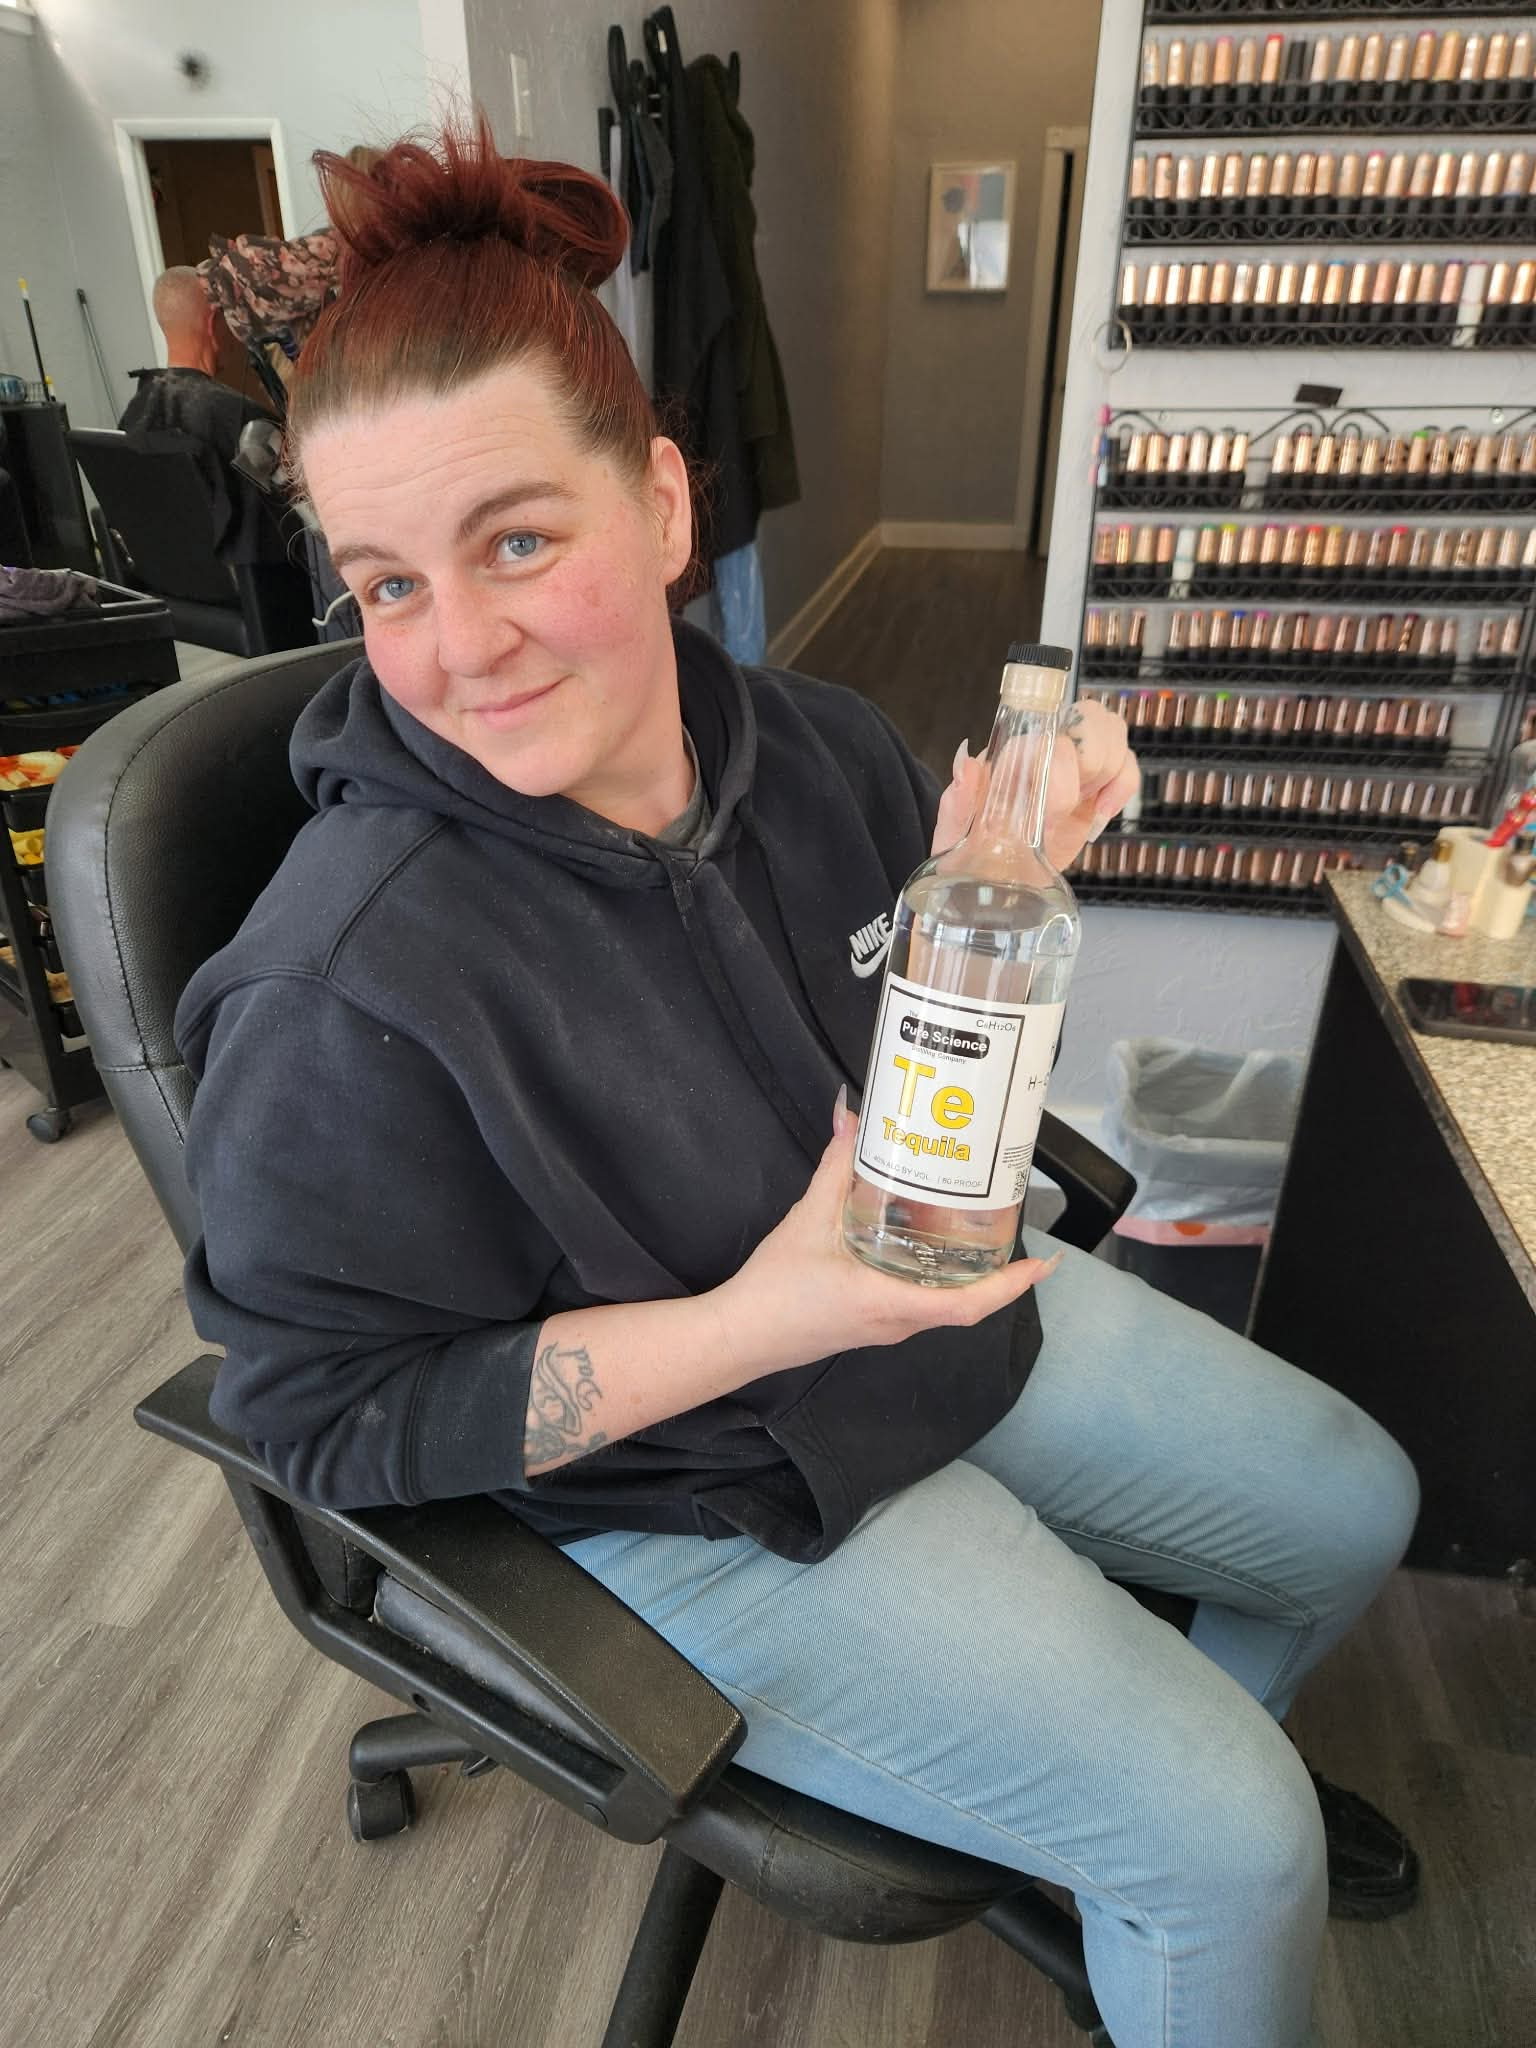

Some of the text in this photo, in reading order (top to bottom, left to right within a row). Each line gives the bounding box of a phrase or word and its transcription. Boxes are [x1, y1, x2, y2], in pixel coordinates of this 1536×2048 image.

[848, 912, 892, 960] NIKE
[902, 1020, 987, 1051] Pure Science
[938, 1052, 967, 1065] Company
[893, 1054, 976, 1130] Te
[882, 1116, 972, 1162] Tequila
[901, 1165, 914, 1177] BY
[954, 1179, 984, 1189] PROOF
